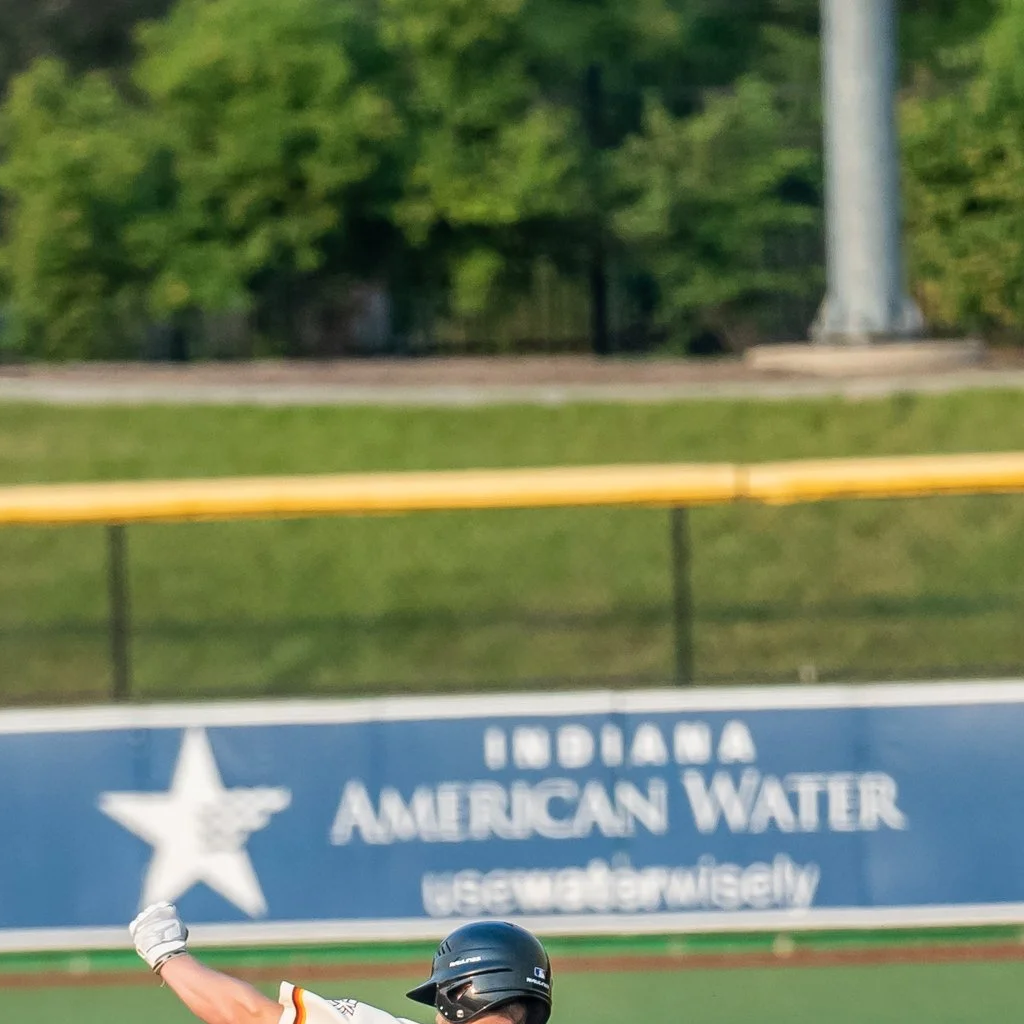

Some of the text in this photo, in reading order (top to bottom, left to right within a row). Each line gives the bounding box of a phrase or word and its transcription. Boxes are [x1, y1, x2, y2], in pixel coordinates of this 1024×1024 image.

[482, 719, 758, 770] INDIANA
[329, 767, 908, 845] AMERICAN WATER
